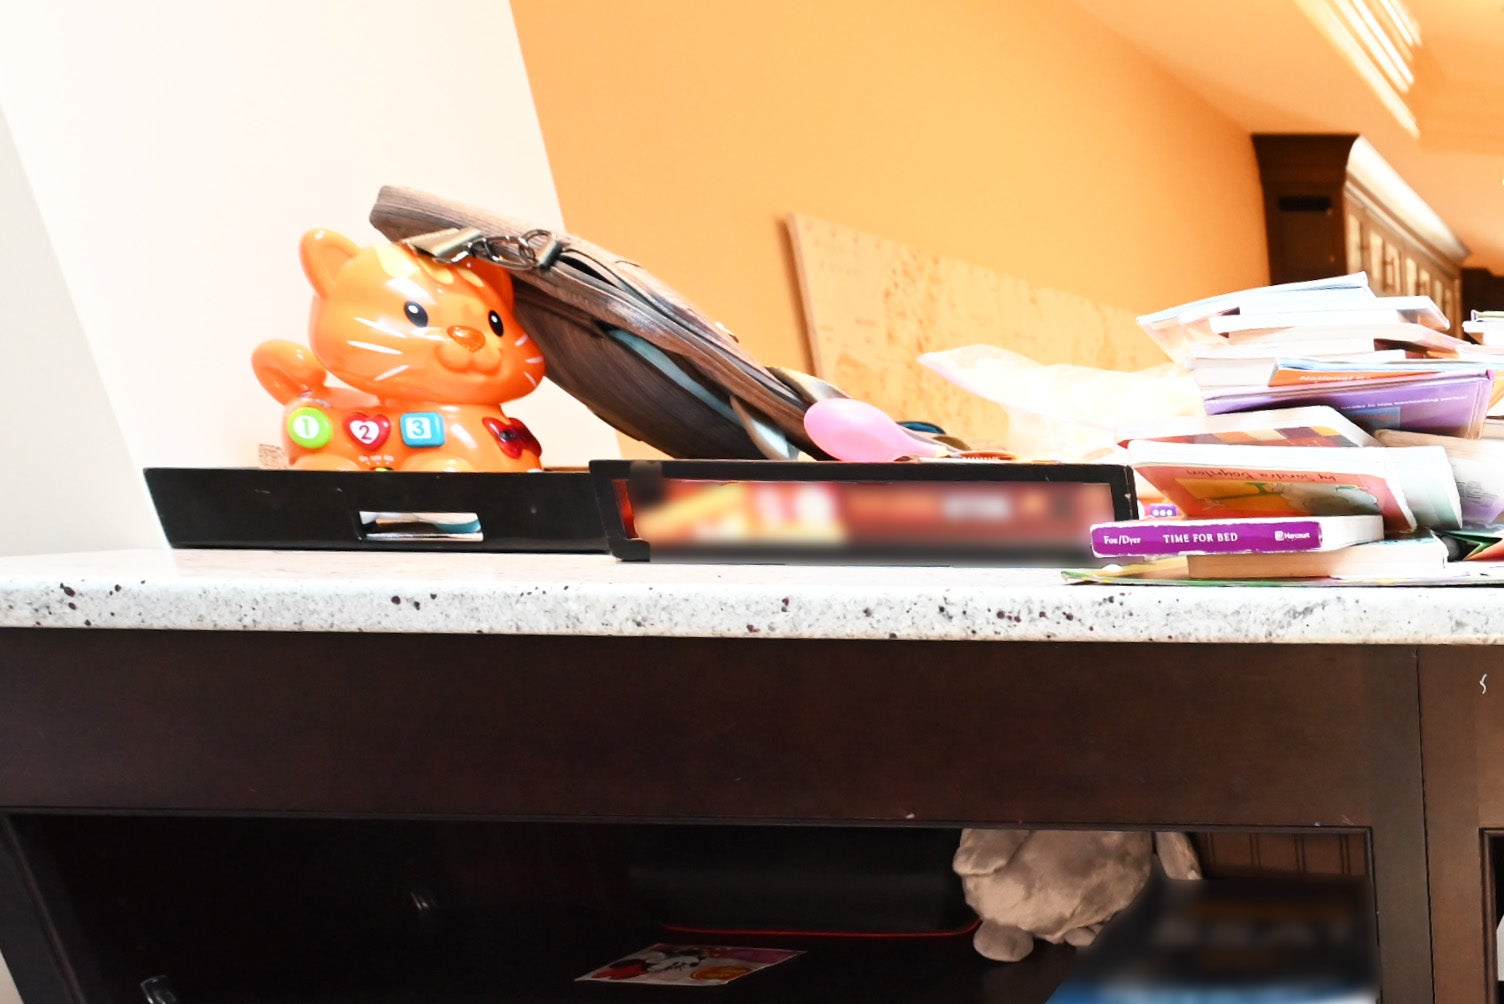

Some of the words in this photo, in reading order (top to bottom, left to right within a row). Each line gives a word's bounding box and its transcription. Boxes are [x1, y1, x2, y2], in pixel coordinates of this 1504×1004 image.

[302, 418, 310, 436] 1
[359, 425, 373, 440] 2
[411, 420, 425, 436] 3
[1103, 535, 1142, 546] Fox/Dyer
[1163, 534, 1189, 544] TIME
[1192, 533, 1213, 543] FOR
[1217, 532, 1239, 543] BED
